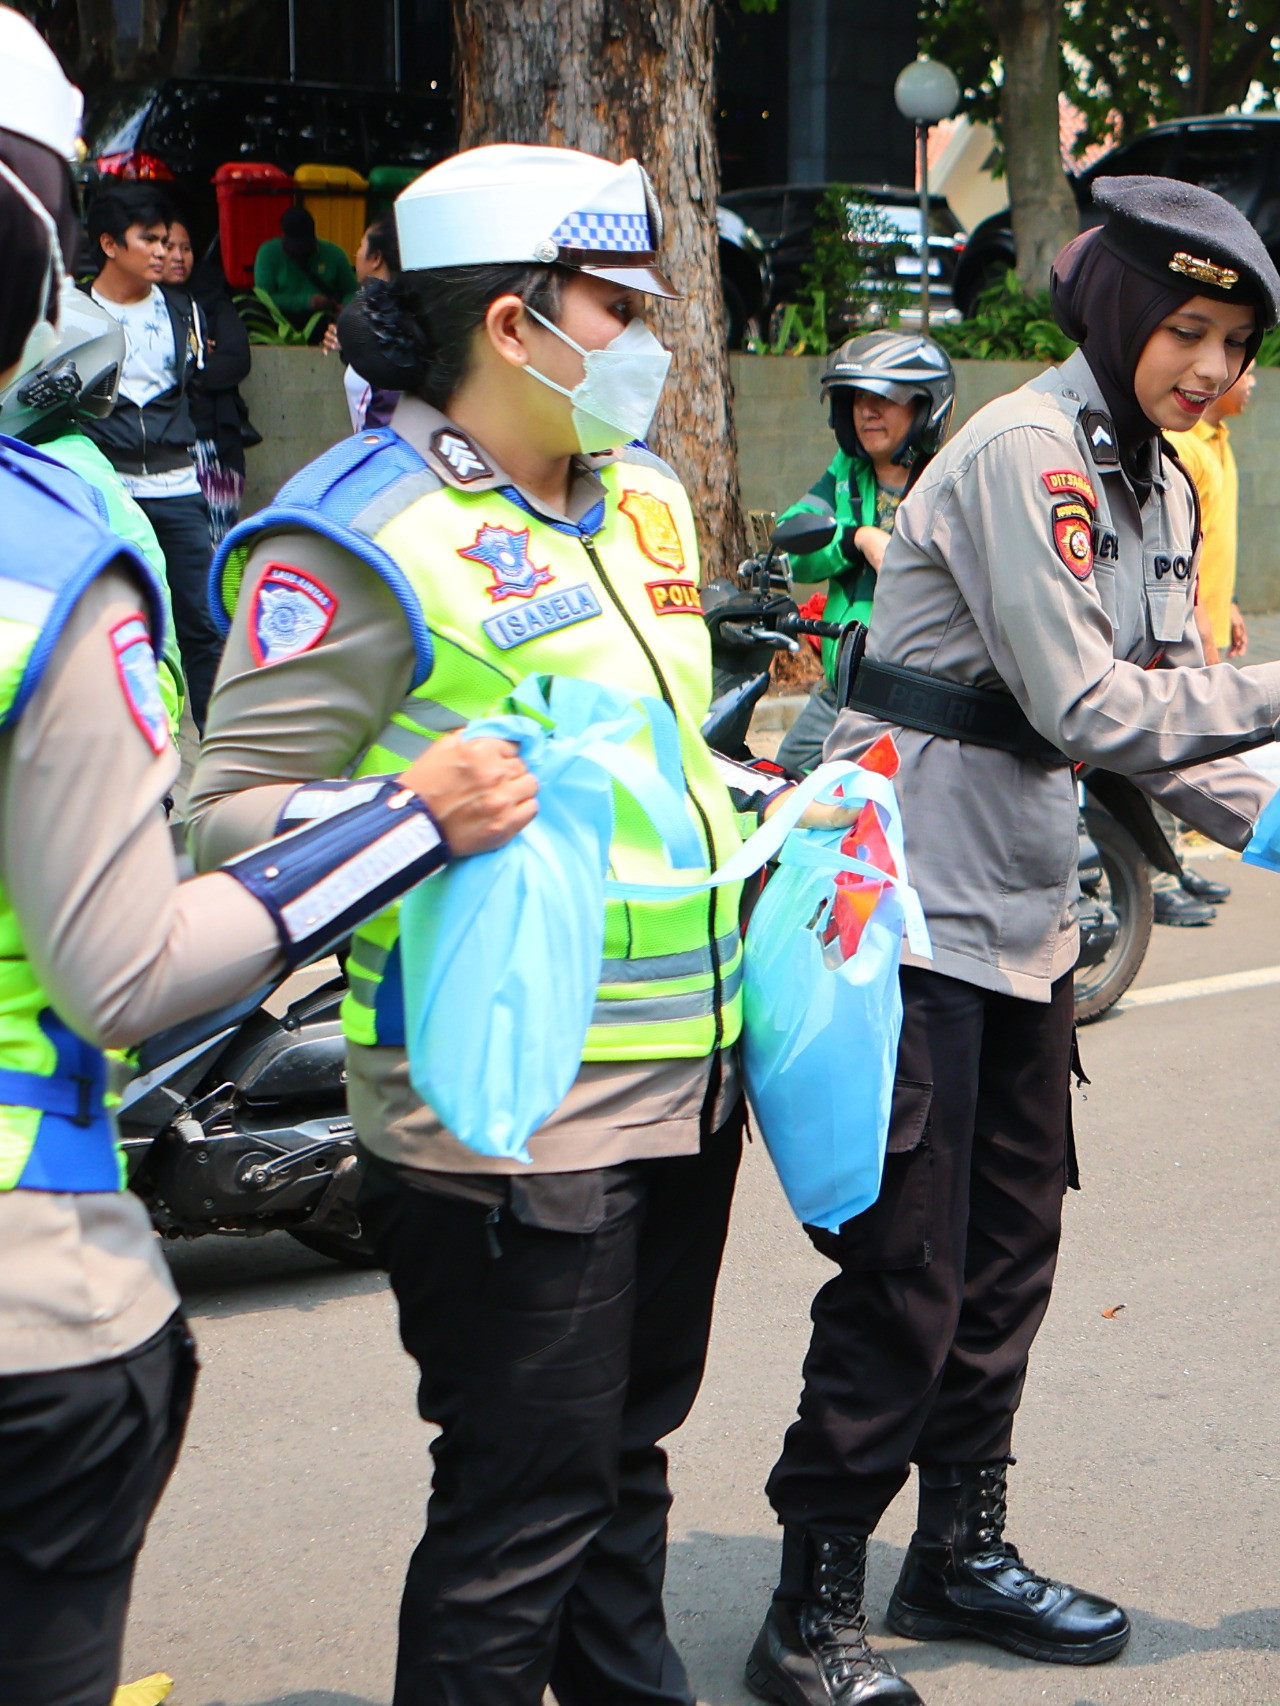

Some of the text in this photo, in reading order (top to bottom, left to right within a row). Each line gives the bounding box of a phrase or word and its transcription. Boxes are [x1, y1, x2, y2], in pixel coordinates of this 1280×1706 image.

[1154, 555, 1192, 580] PO
[495, 589, 596, 643] ISABELA
[889, 683, 975, 726] POLRI
